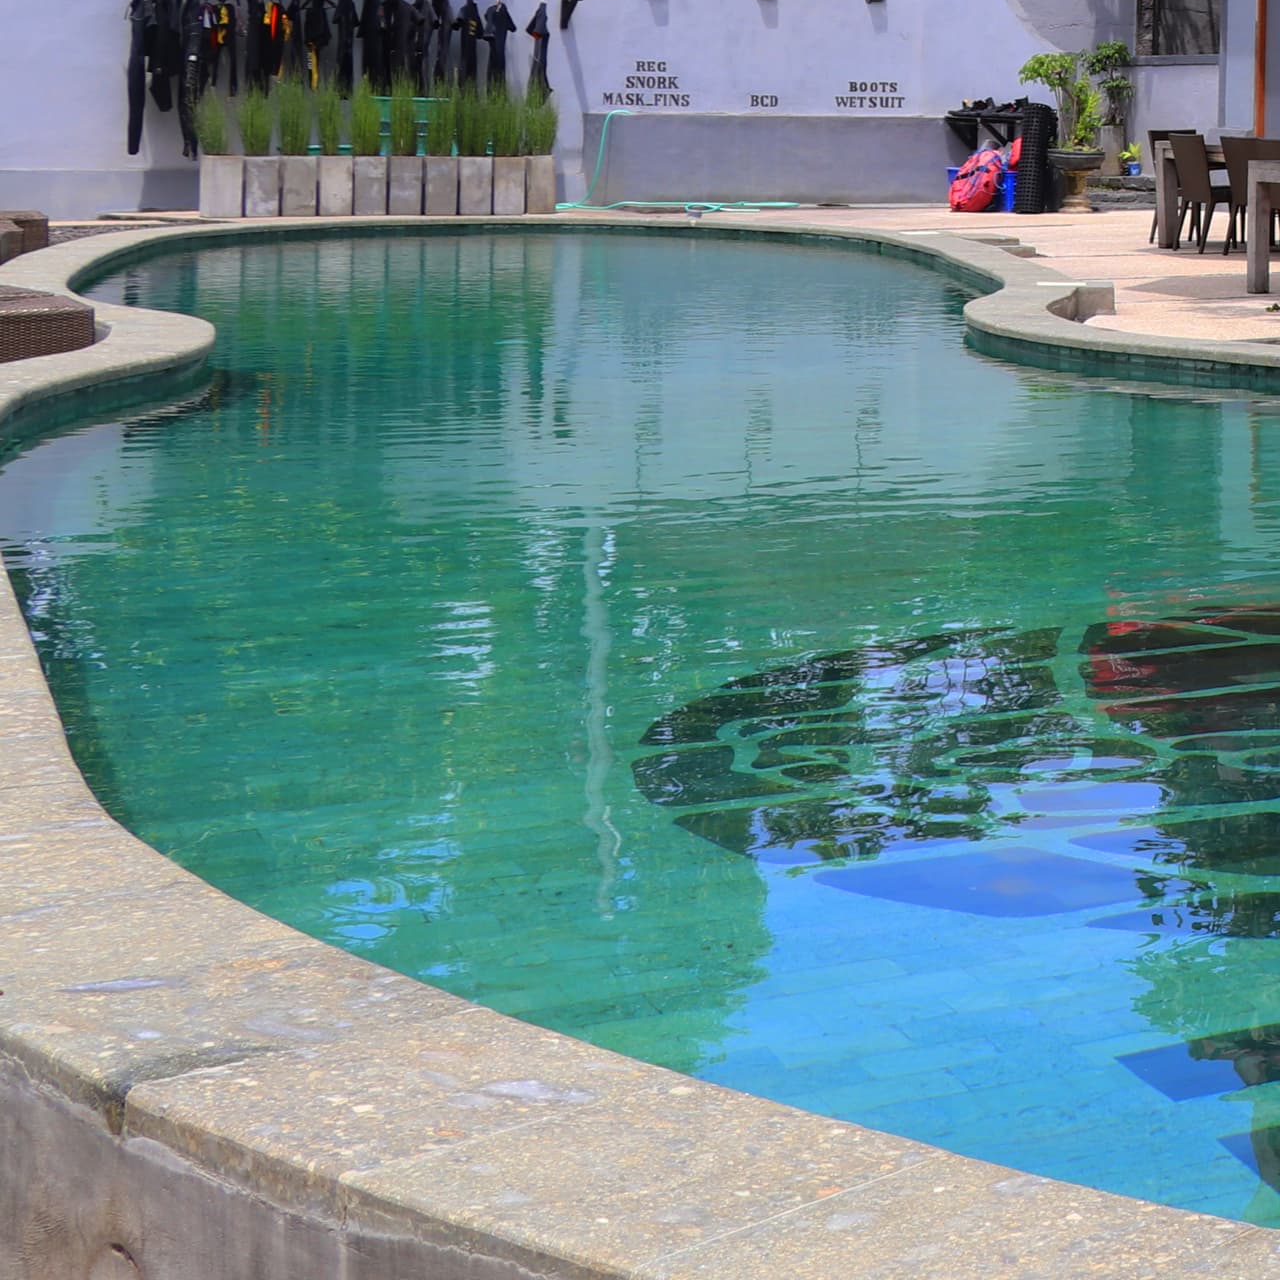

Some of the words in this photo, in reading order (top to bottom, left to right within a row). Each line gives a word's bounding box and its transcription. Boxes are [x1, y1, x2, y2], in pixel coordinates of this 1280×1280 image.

[636, 60, 667, 72] REG
[625, 75, 680, 89] SNORK
[848, 81, 898, 93] BOOTS
[750, 95, 779, 107] BCD
